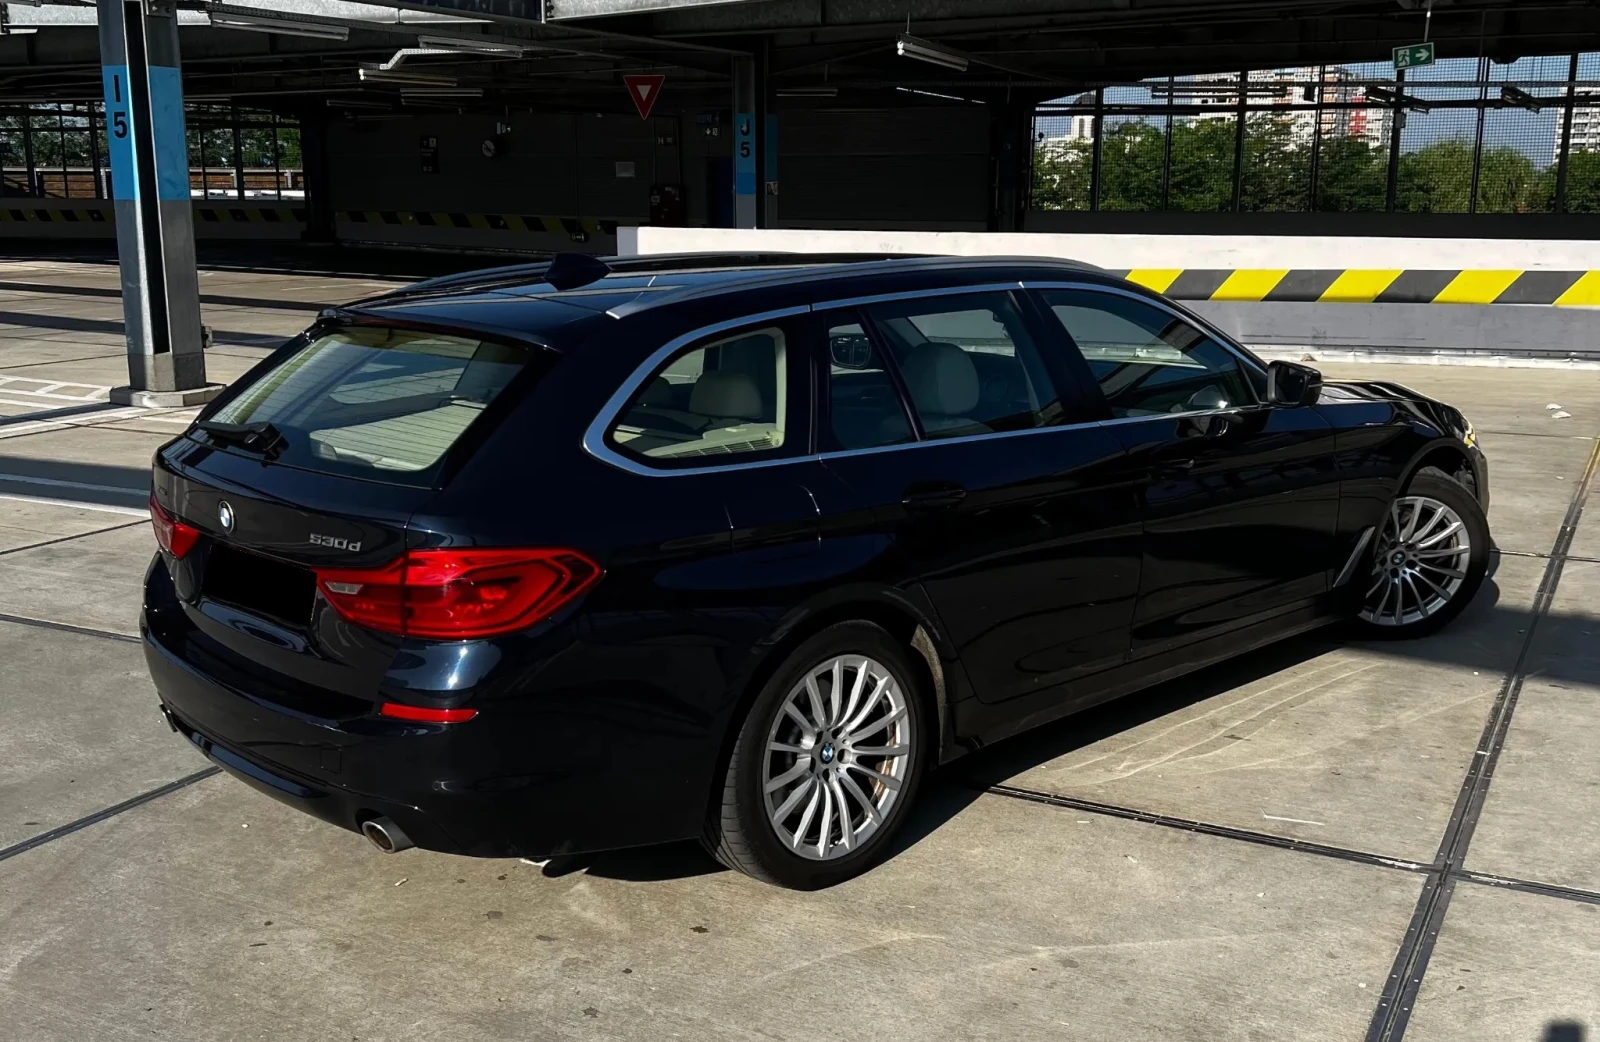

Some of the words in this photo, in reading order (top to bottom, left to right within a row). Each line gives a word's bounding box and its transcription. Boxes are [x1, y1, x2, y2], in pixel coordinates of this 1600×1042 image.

[113, 111, 128, 138] 5
[740, 119, 750, 136] J
[740, 141, 751, 158] 5
[309, 532, 361, 552] 530d
